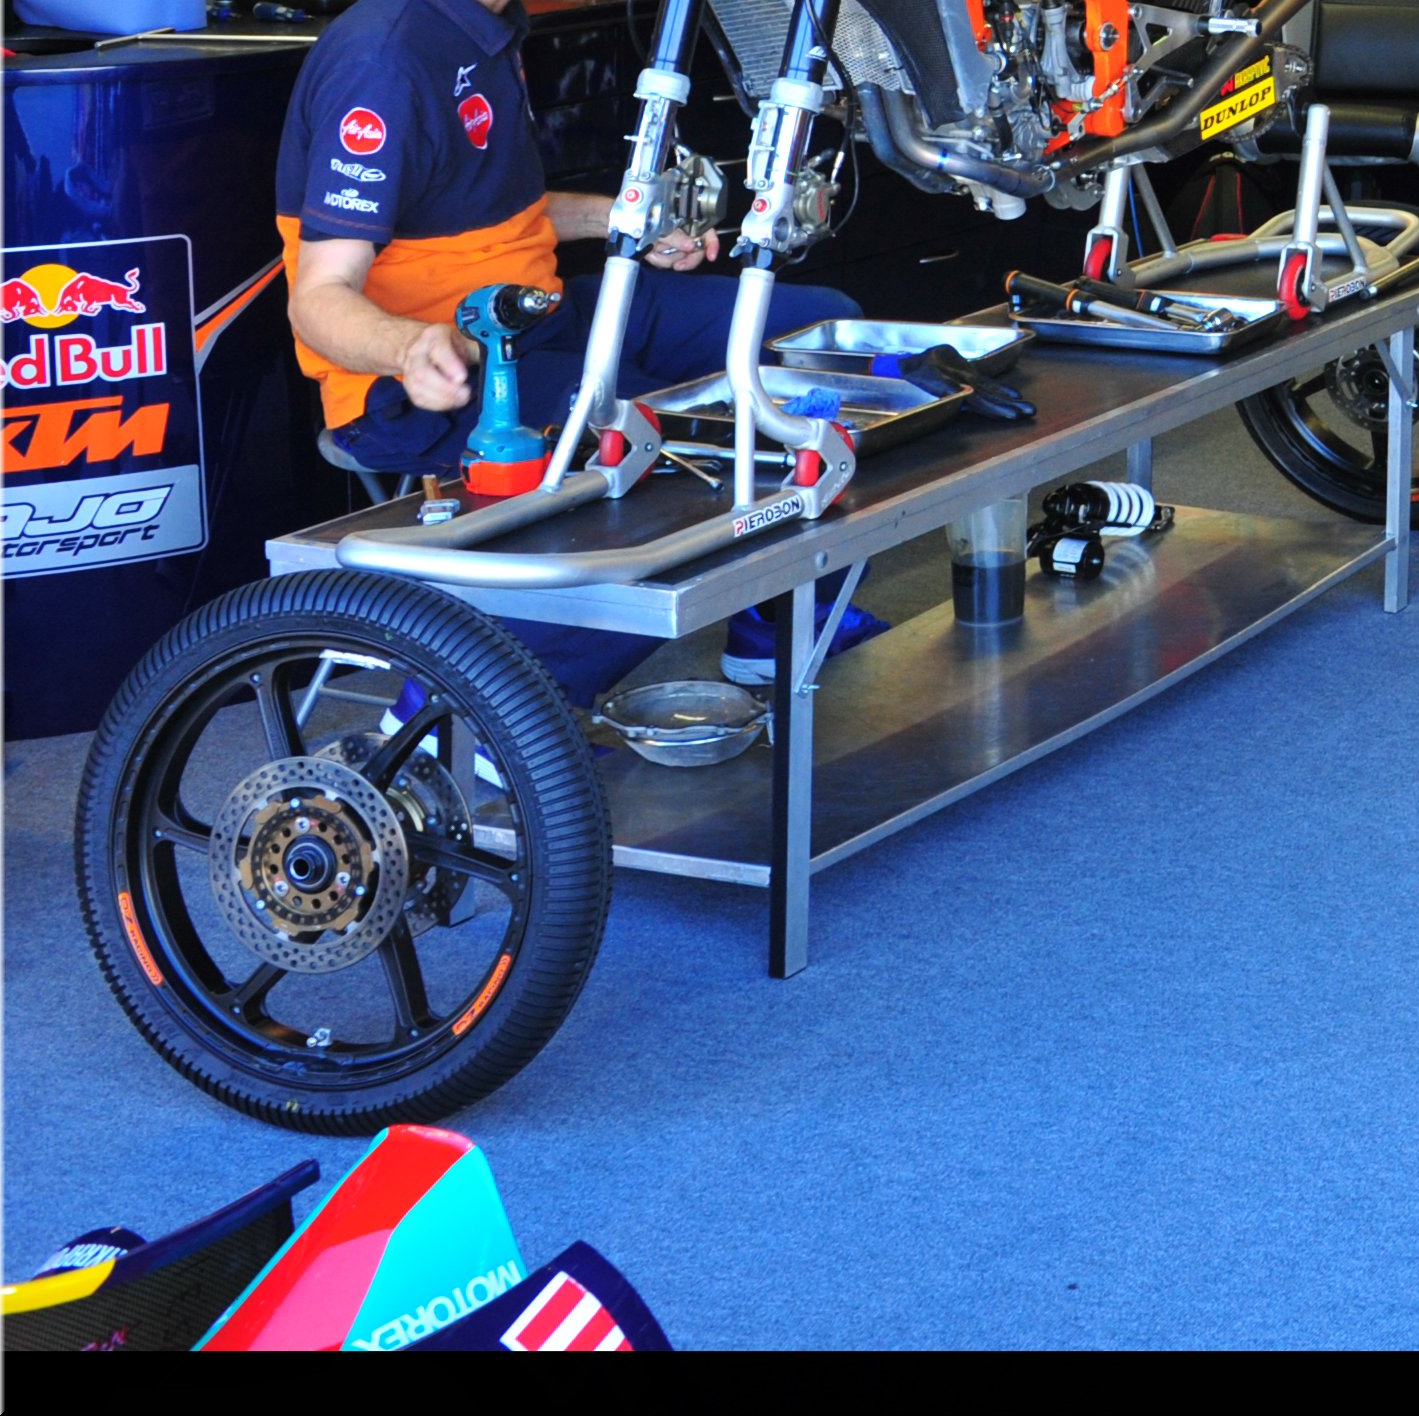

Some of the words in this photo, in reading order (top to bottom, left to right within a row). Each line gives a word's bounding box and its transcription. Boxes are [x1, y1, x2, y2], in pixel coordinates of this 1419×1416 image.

[1202, 85, 1272, 131] DUNLOP
[323, 190, 380, 214] MOTOREX
[54, 322, 168, 386] Bull
[734, 495, 801, 536] PIEROBON
